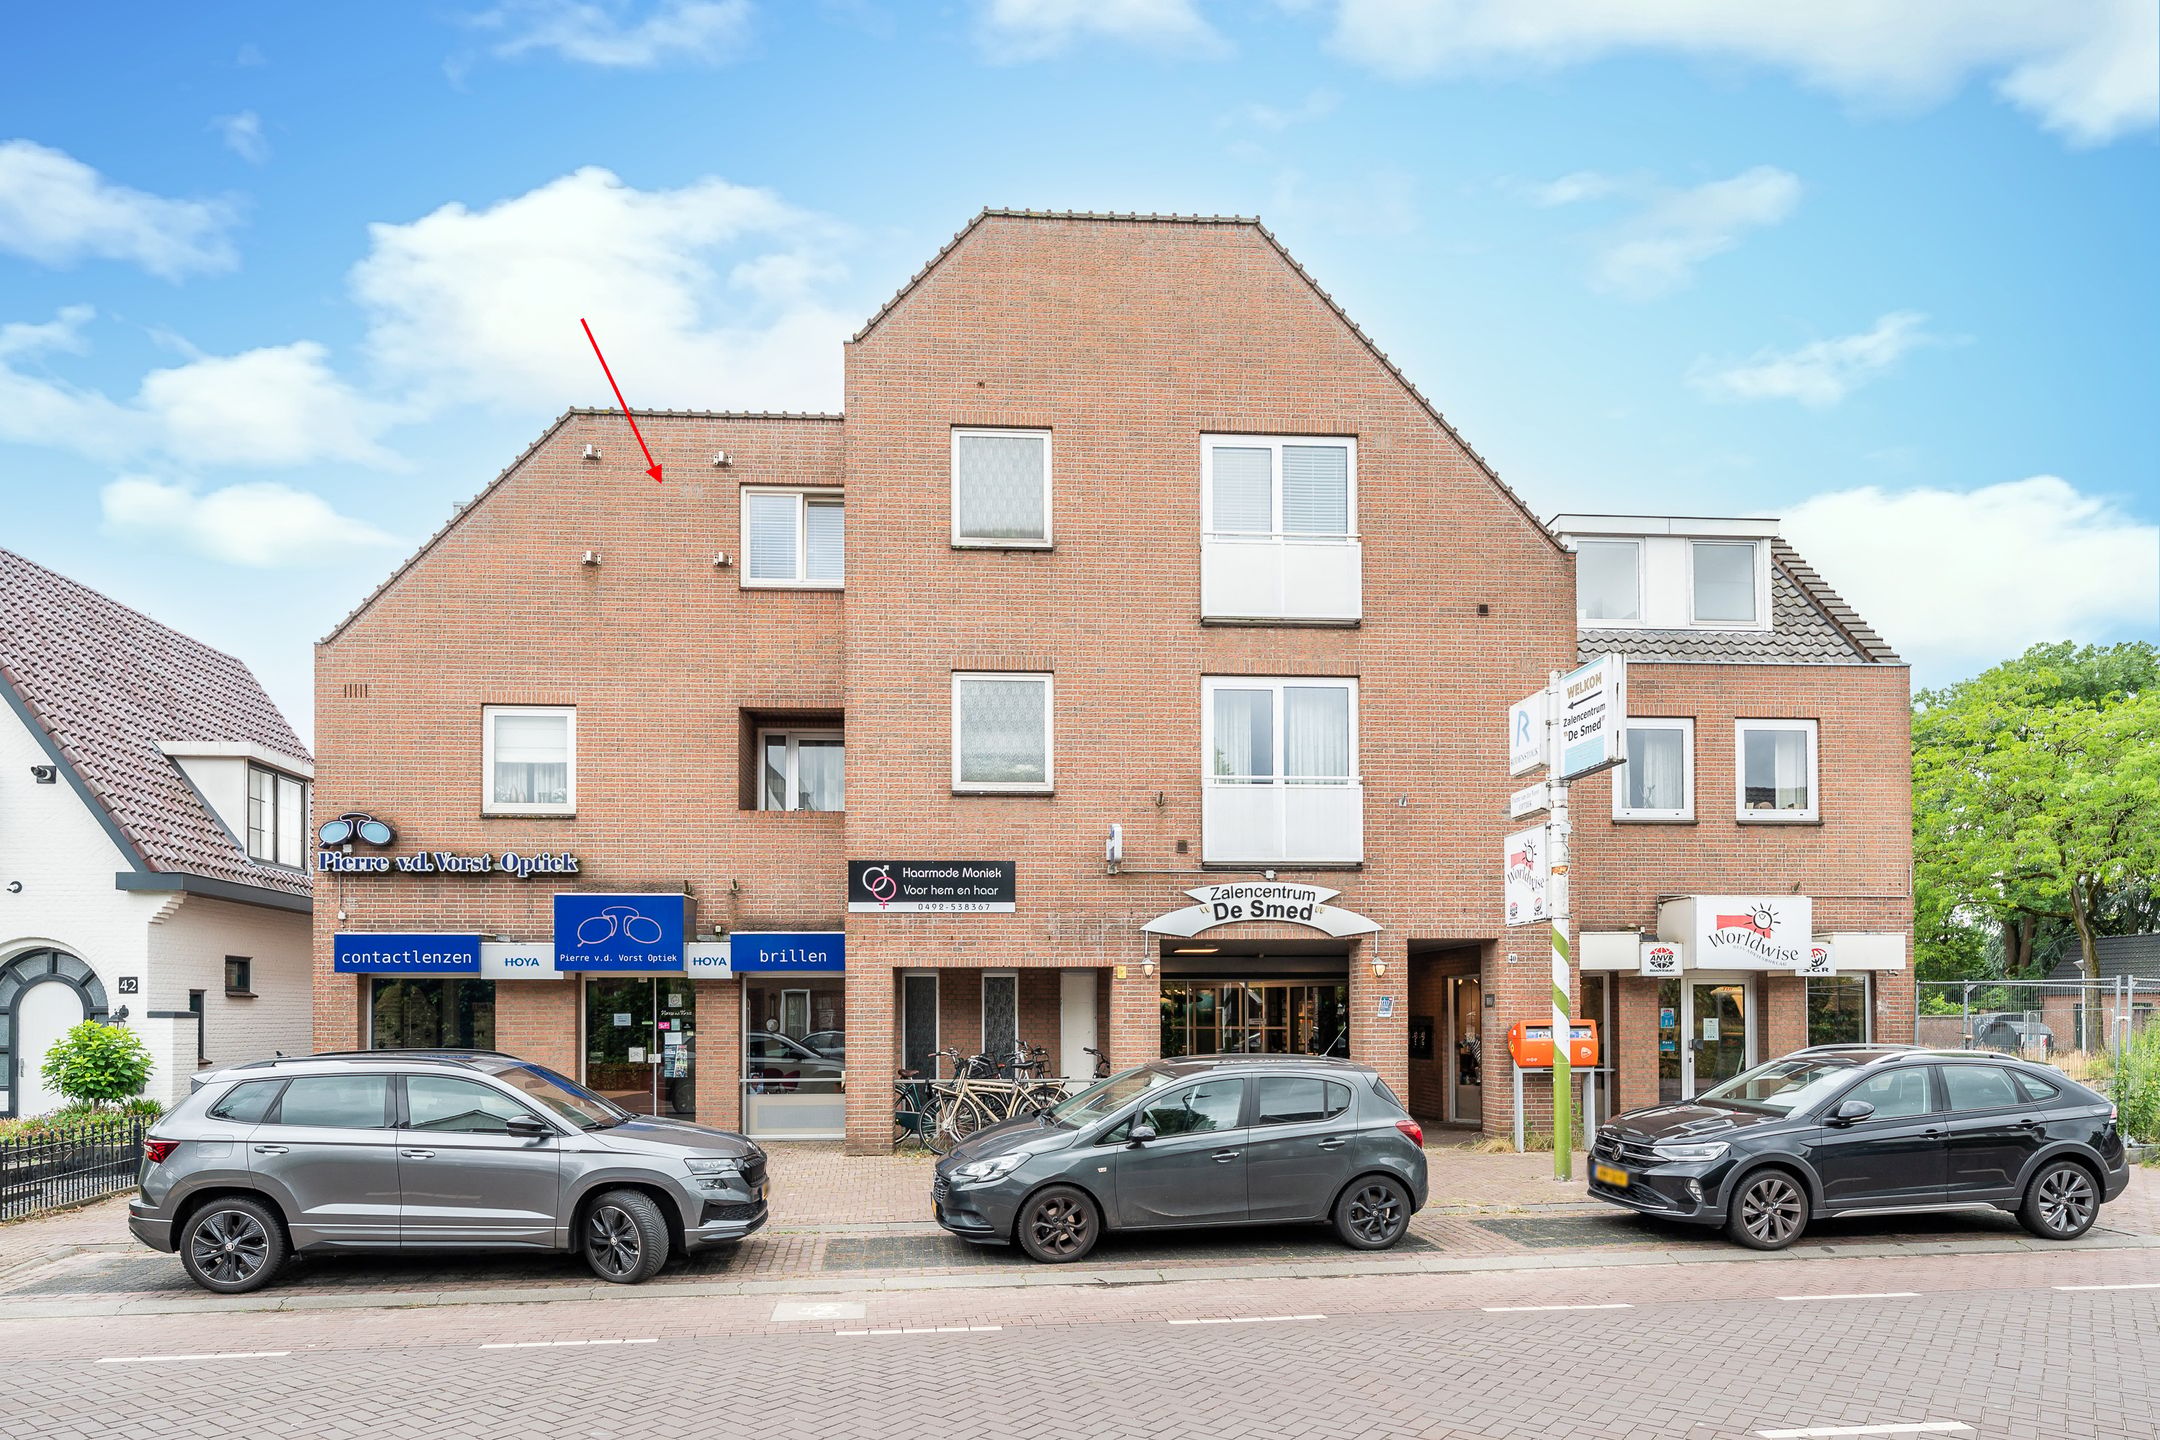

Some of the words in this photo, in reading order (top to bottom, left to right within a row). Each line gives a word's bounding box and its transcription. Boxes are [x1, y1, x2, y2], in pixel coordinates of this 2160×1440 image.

[1566, 672, 1602, 699] WELKOM
[1563, 703, 1606, 728] Zalencentrum
[318, 852, 389, 872] Pierre
[433, 852, 491, 872] Vorst
[501, 852, 579, 877] Optiek
[902, 867, 960, 878] Haarmode
[962, 867, 1002, 878] Moniek
[1506, 866, 1545, 892] Worldwise
[903, 885, 928, 895] Voor
[930, 885, 954, 895] hem
[957, 887, 971, 895] en
[973, 885, 999, 895] haar
[1210, 885, 1316, 901] Zalencentrum
[1708, 930, 1799, 961] Worldwise
[341, 950, 472, 964] contactlenzen
[505, 957, 540, 967] HOYA
[560, 954, 590, 962] Pierre
[594, 954, 613, 962] v.d.
[618, 954, 643, 962] Vorst
[647, 954, 678, 964] Optiek
[693, 957, 727, 966] HOYA
[760, 949, 827, 963] brillen
[119, 979, 137, 992] 42
